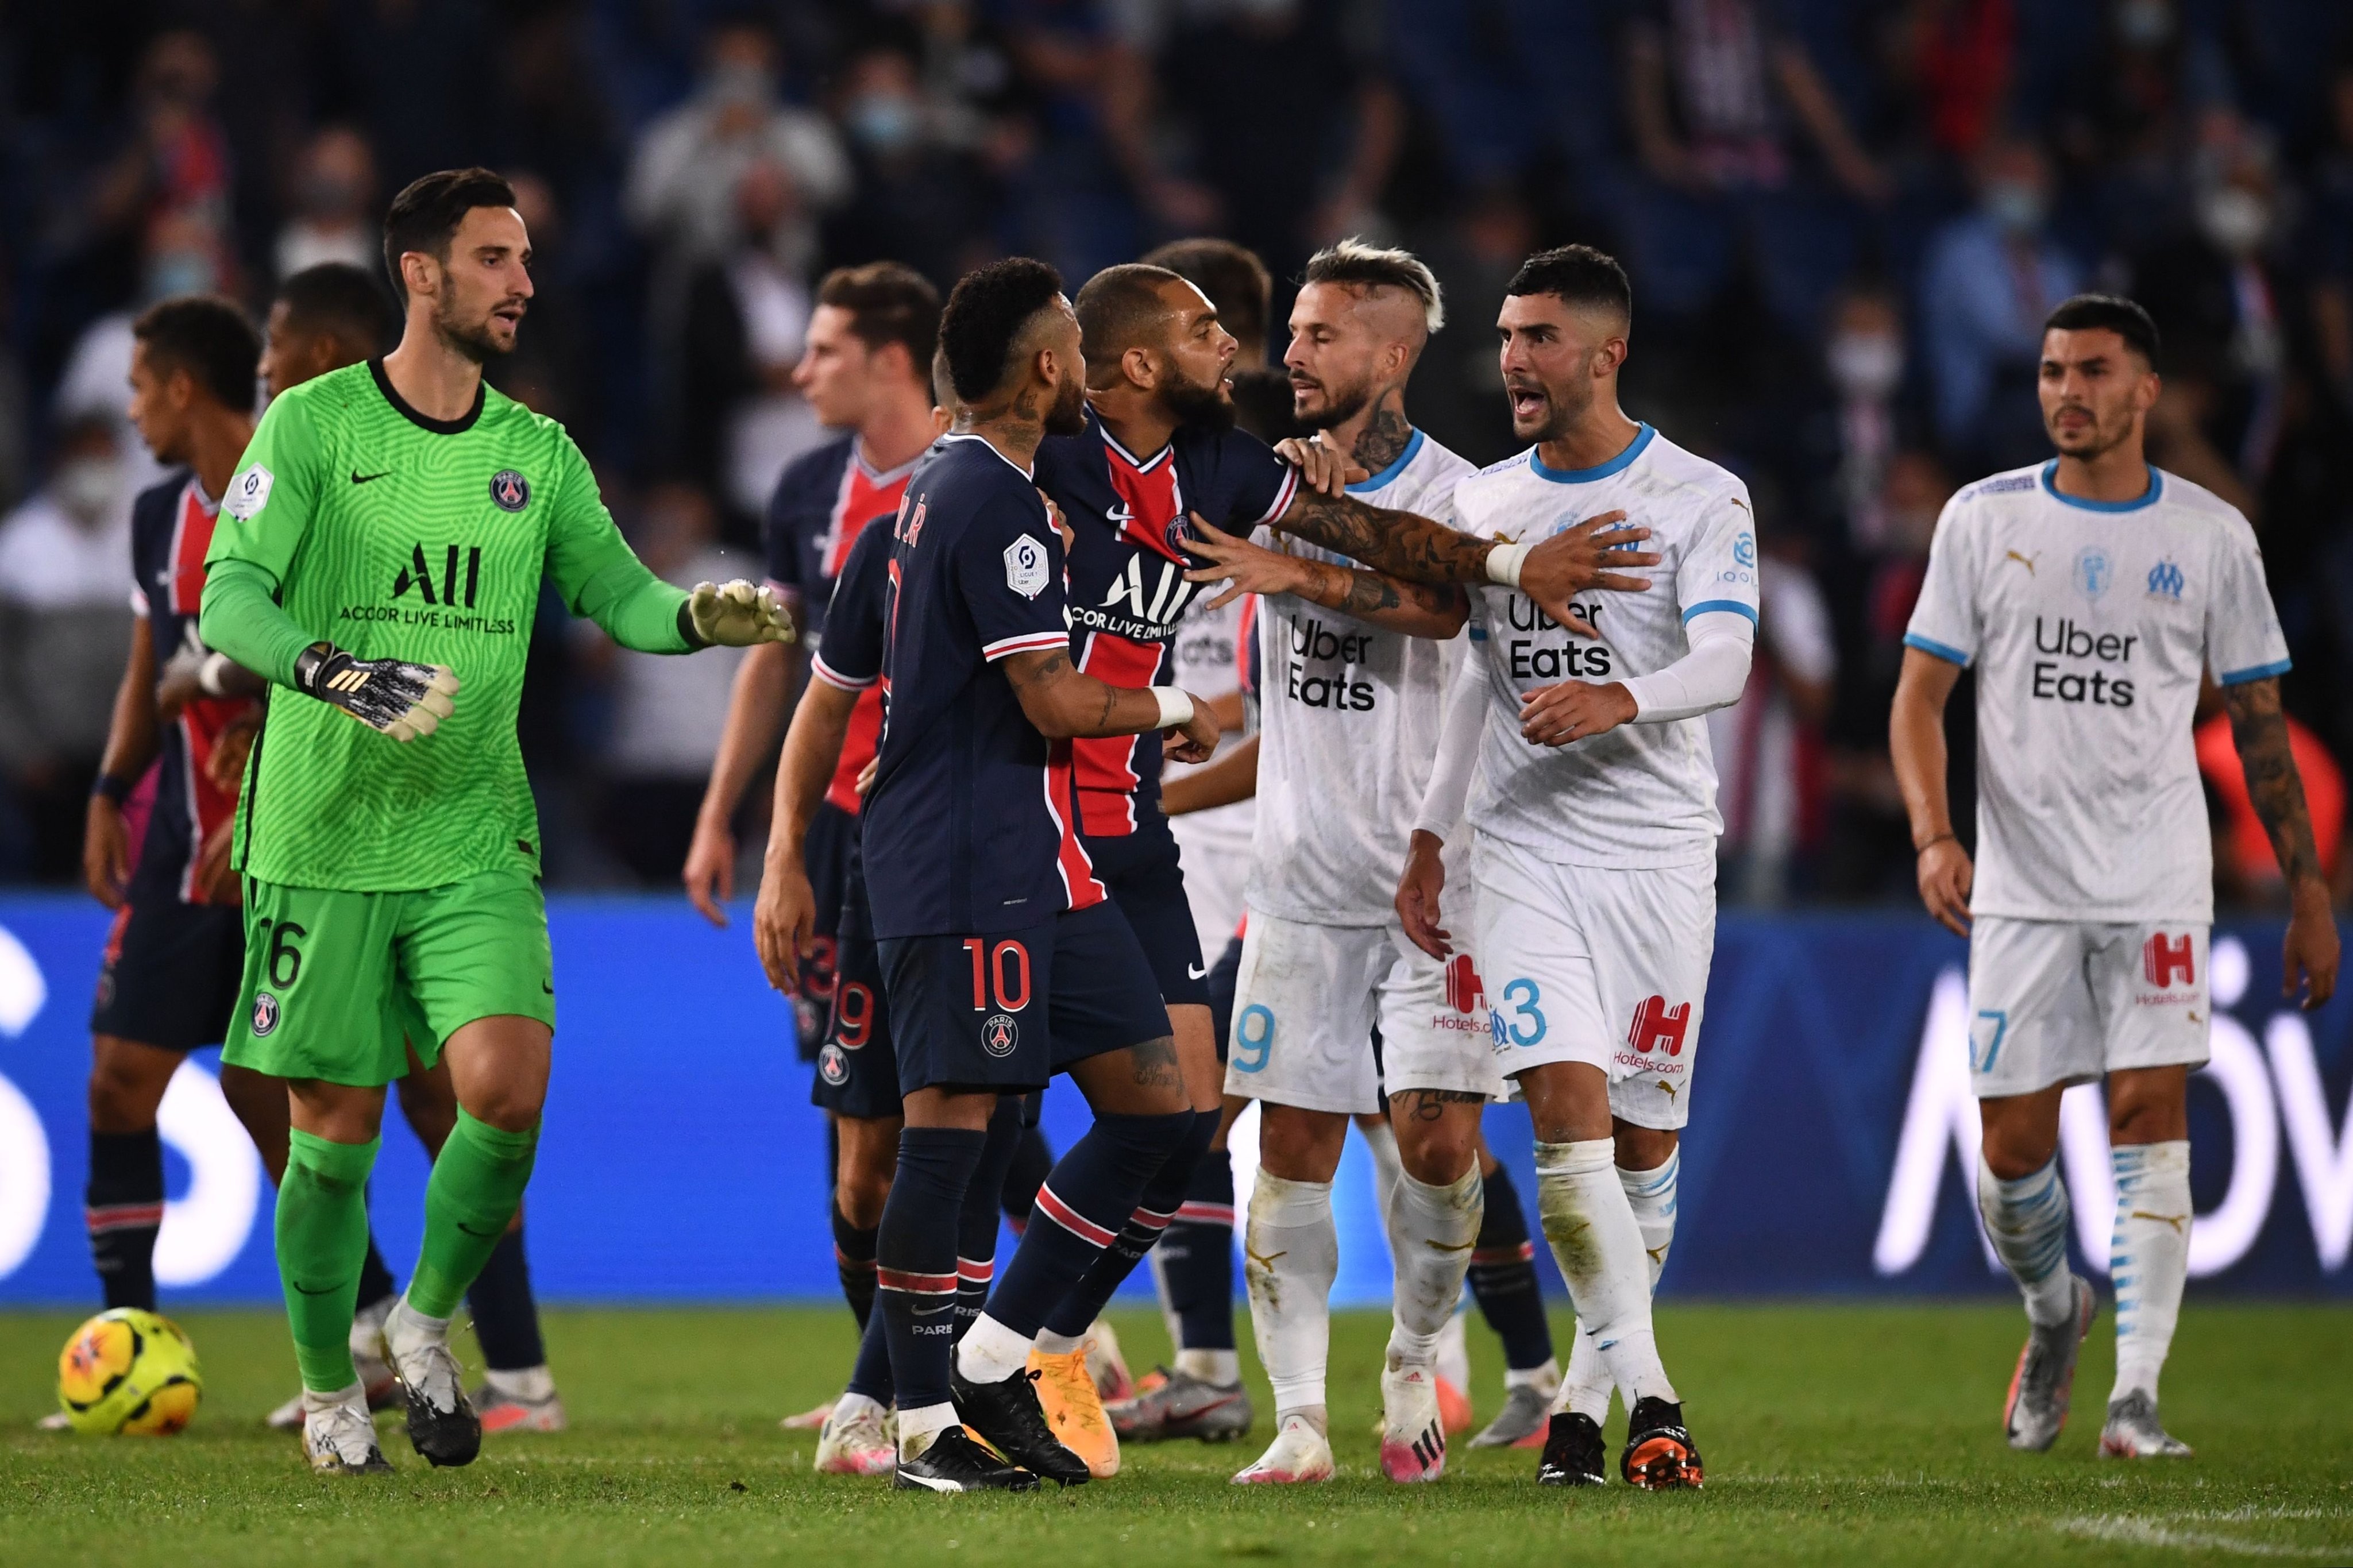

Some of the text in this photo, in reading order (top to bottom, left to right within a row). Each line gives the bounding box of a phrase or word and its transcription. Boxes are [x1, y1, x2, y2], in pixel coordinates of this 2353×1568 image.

[1170, 519, 1189, 530] PARIS
[340, 606, 515, 634] ACCOR LIVE LIMITLESS
[1073, 607, 1106, 628] COR
[1108, 616, 1145, 639] LIVE
[1291, 615, 1373, 664] Uber
[2036, 616, 2138, 662] Uber
[1511, 640, 1611, 678] Eats
[1289, 661, 1375, 711] Eats
[2034, 662, 2135, 707] Eats
[963, 938, 1031, 1013] 10
[836, 981, 874, 1050] 9
[988, 1016, 1013, 1028] PARIS
[1432, 1015, 1492, 1034] Hotels.c
[1503, 978, 1547, 1047] 3
[1232, 1003, 1275, 1073] 9
[1978, 1010, 2007, 1073] 7
[1613, 1051, 1684, 1073] Hotels.com
[912, 1323, 953, 1335] PARIS
[955, 1306, 981, 1316] RIS
